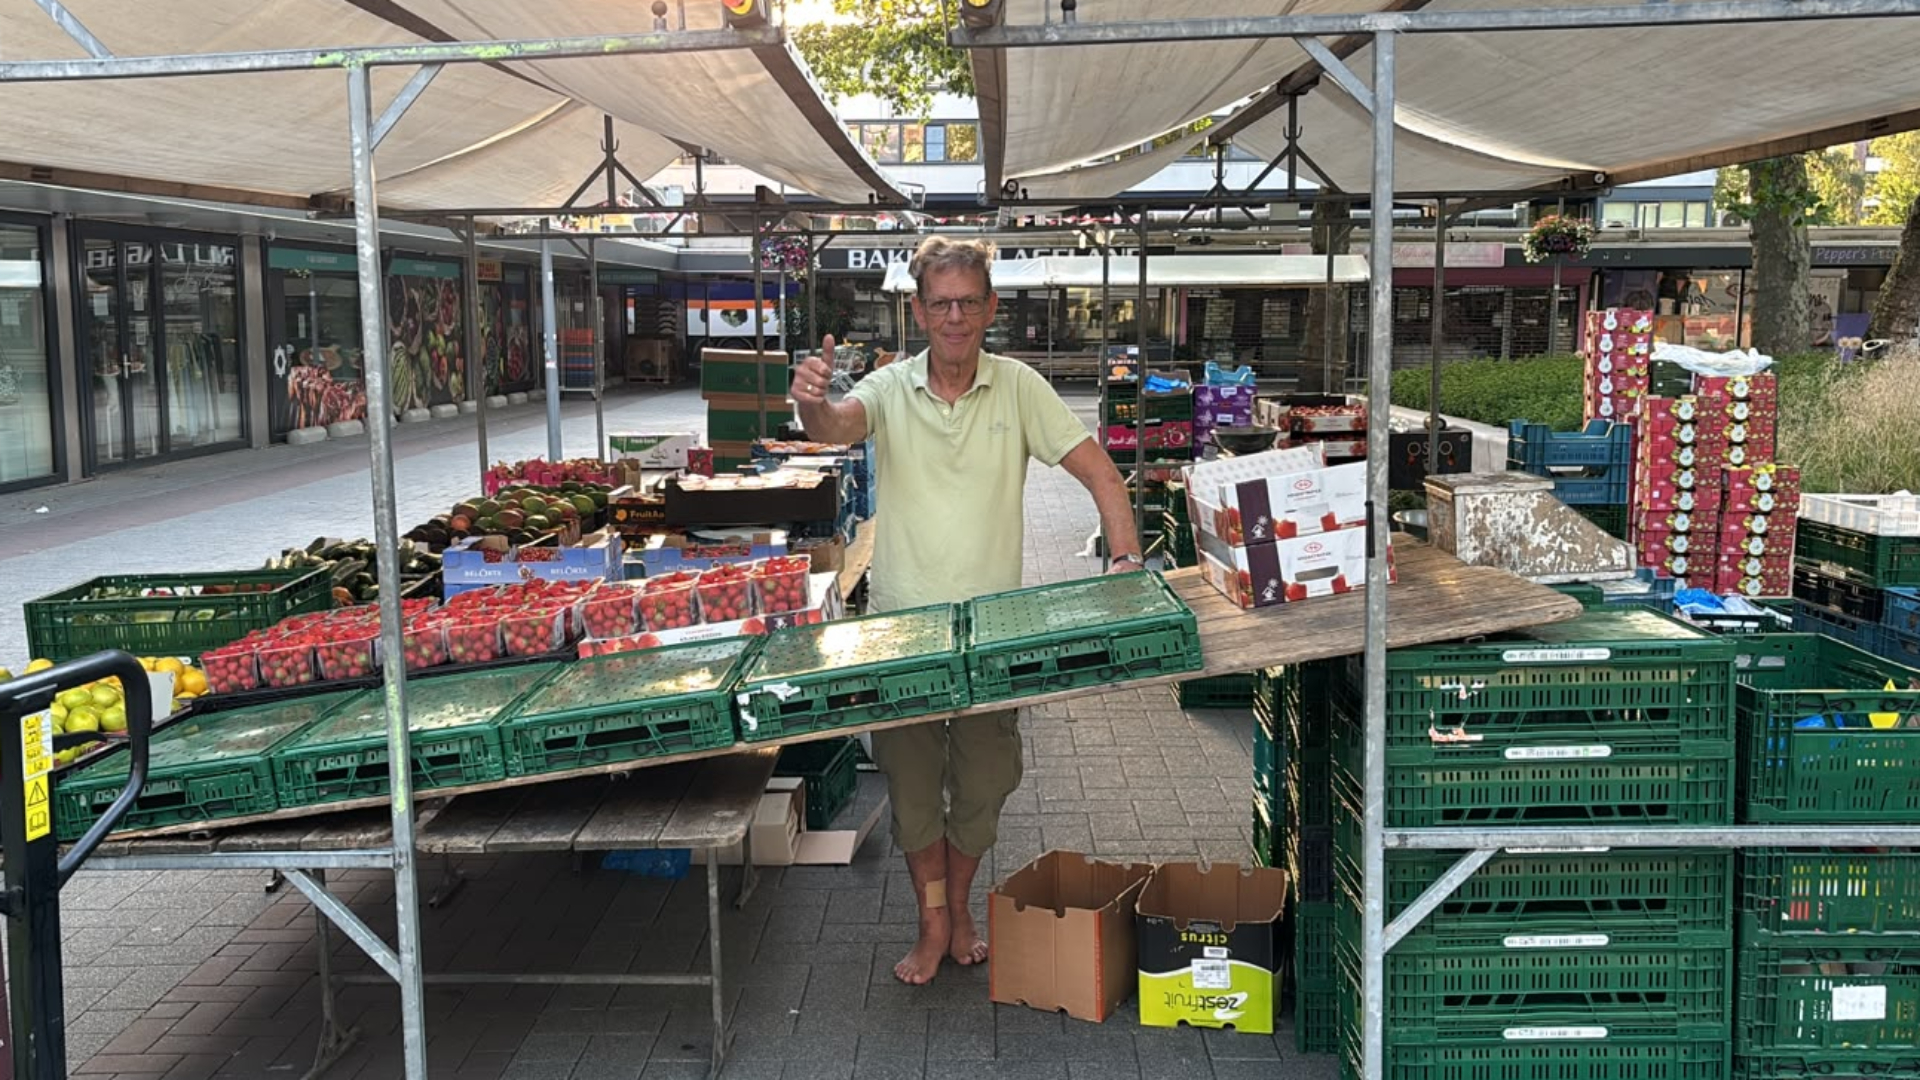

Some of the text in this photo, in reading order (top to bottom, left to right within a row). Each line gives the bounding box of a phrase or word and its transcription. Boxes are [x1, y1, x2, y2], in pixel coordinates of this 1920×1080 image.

[1815, 247, 1867, 263] Pepper's
[1181, 932, 1227, 945] citrus
[1164, 992, 1238, 1012] zestfruit
